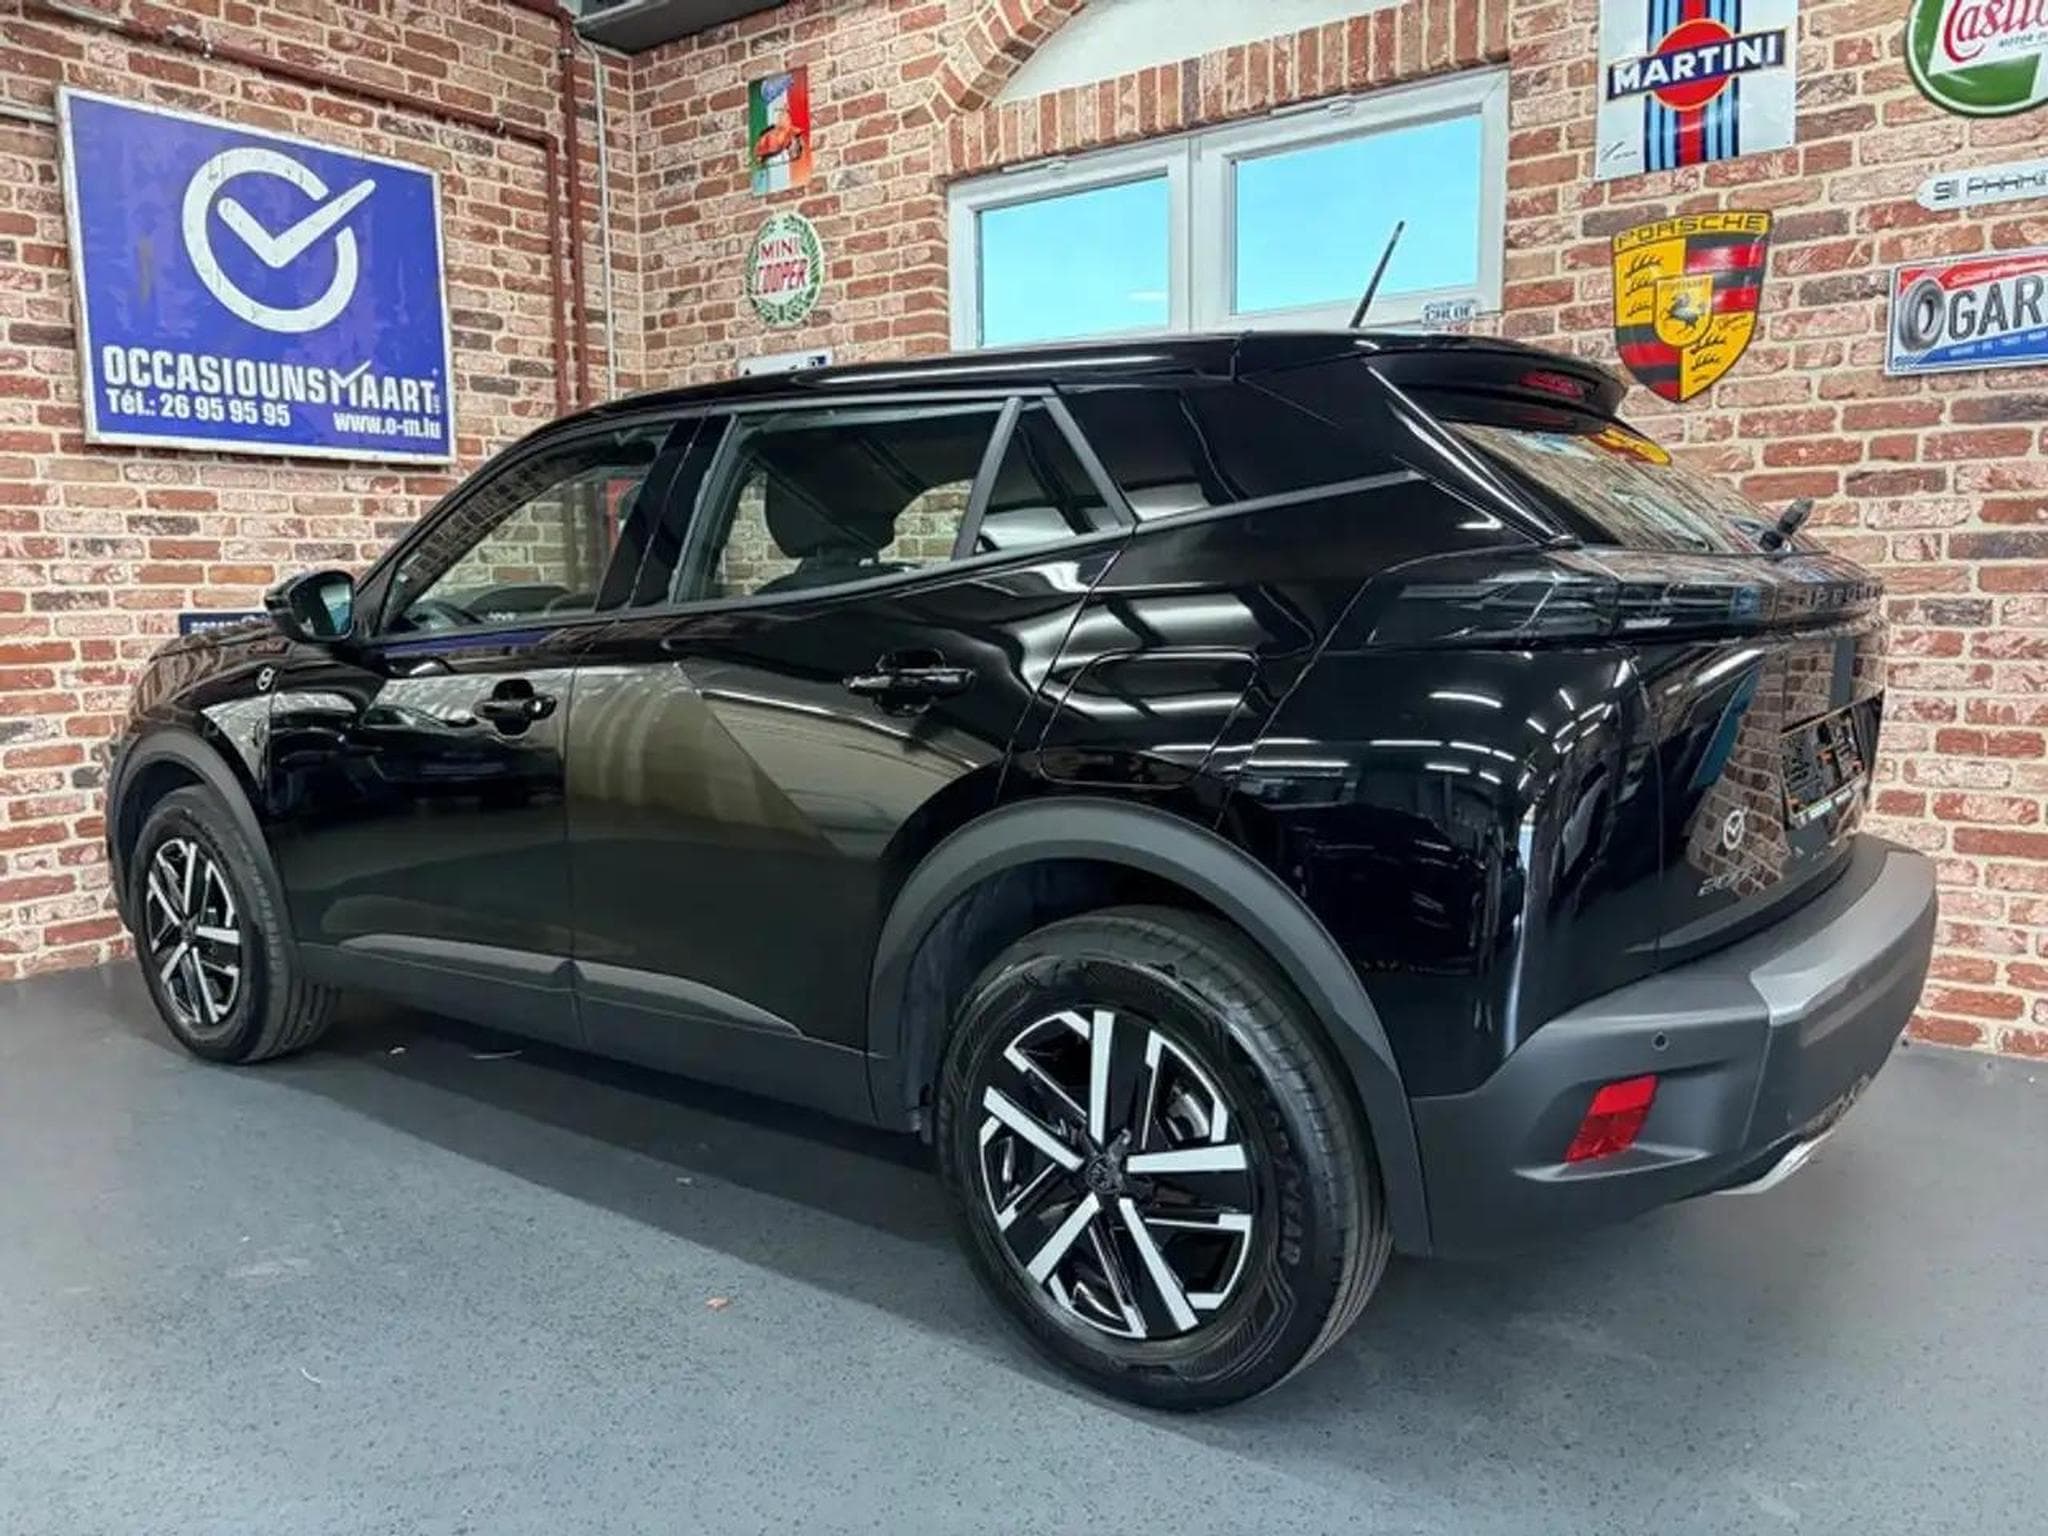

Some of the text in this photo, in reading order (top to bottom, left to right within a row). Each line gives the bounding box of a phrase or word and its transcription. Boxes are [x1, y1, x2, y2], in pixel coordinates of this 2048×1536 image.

[1613, 35, 1777, 94] MARTINI
[759, 235, 800, 260] MINI
[1618, 214, 1764, 249] PORSCHE
[754, 258, 809, 295] COOPER
[102, 345, 436, 415] OCCASIOUNSMAART
[105, 387, 291, 427] Tél.: 26 95 95 95
[333, 411, 442, 439] www.o-m.lu
